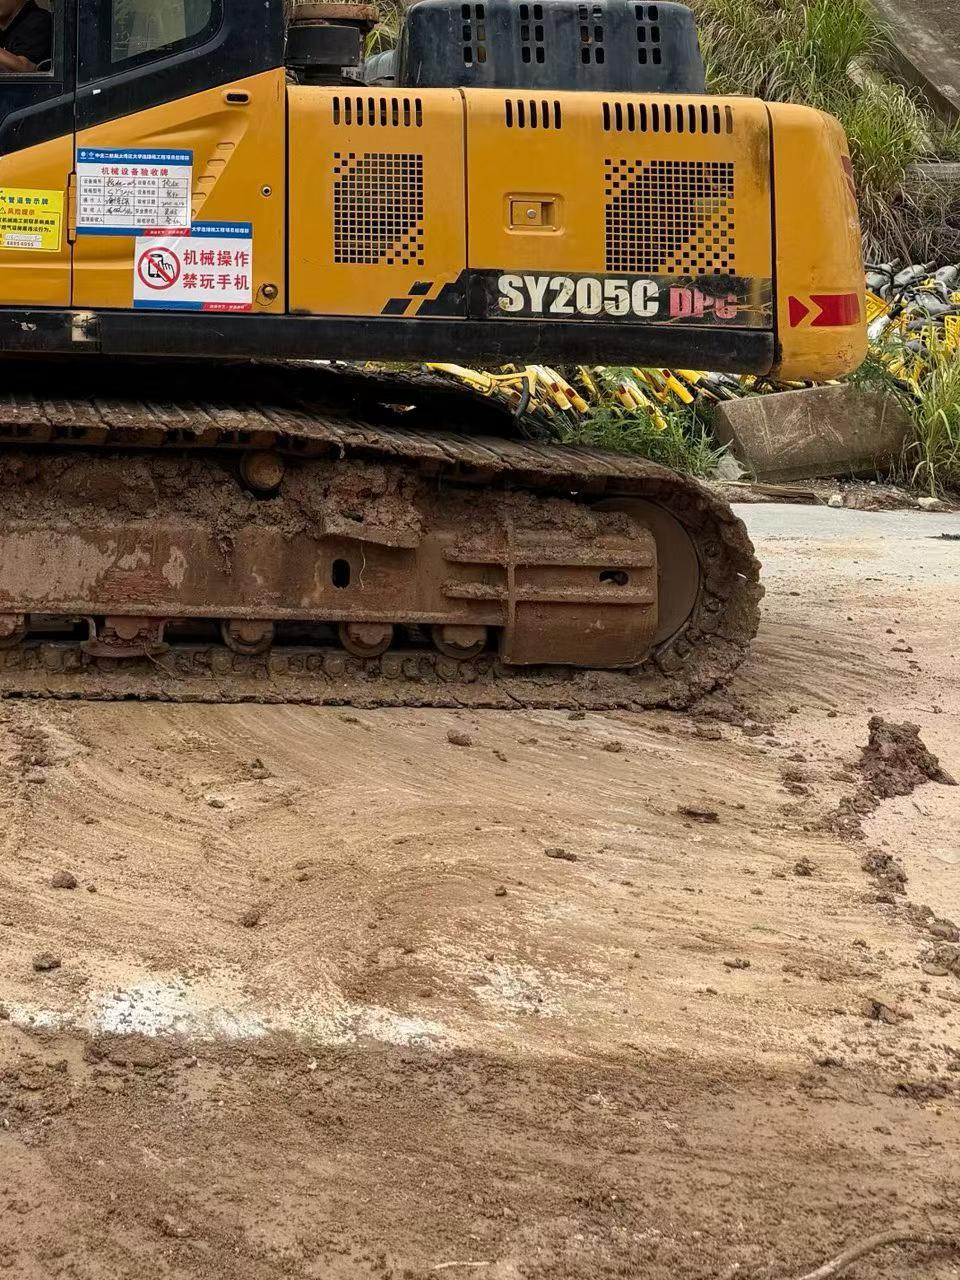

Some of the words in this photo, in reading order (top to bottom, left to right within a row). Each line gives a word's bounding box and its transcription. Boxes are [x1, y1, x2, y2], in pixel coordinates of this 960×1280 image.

[101, 167, 169, 176] 机械设备验收牌
[183, 249, 250, 267] 机械操作
[182, 272, 250, 291] 禁玩手机
[497, 274, 660, 317] SY205C
